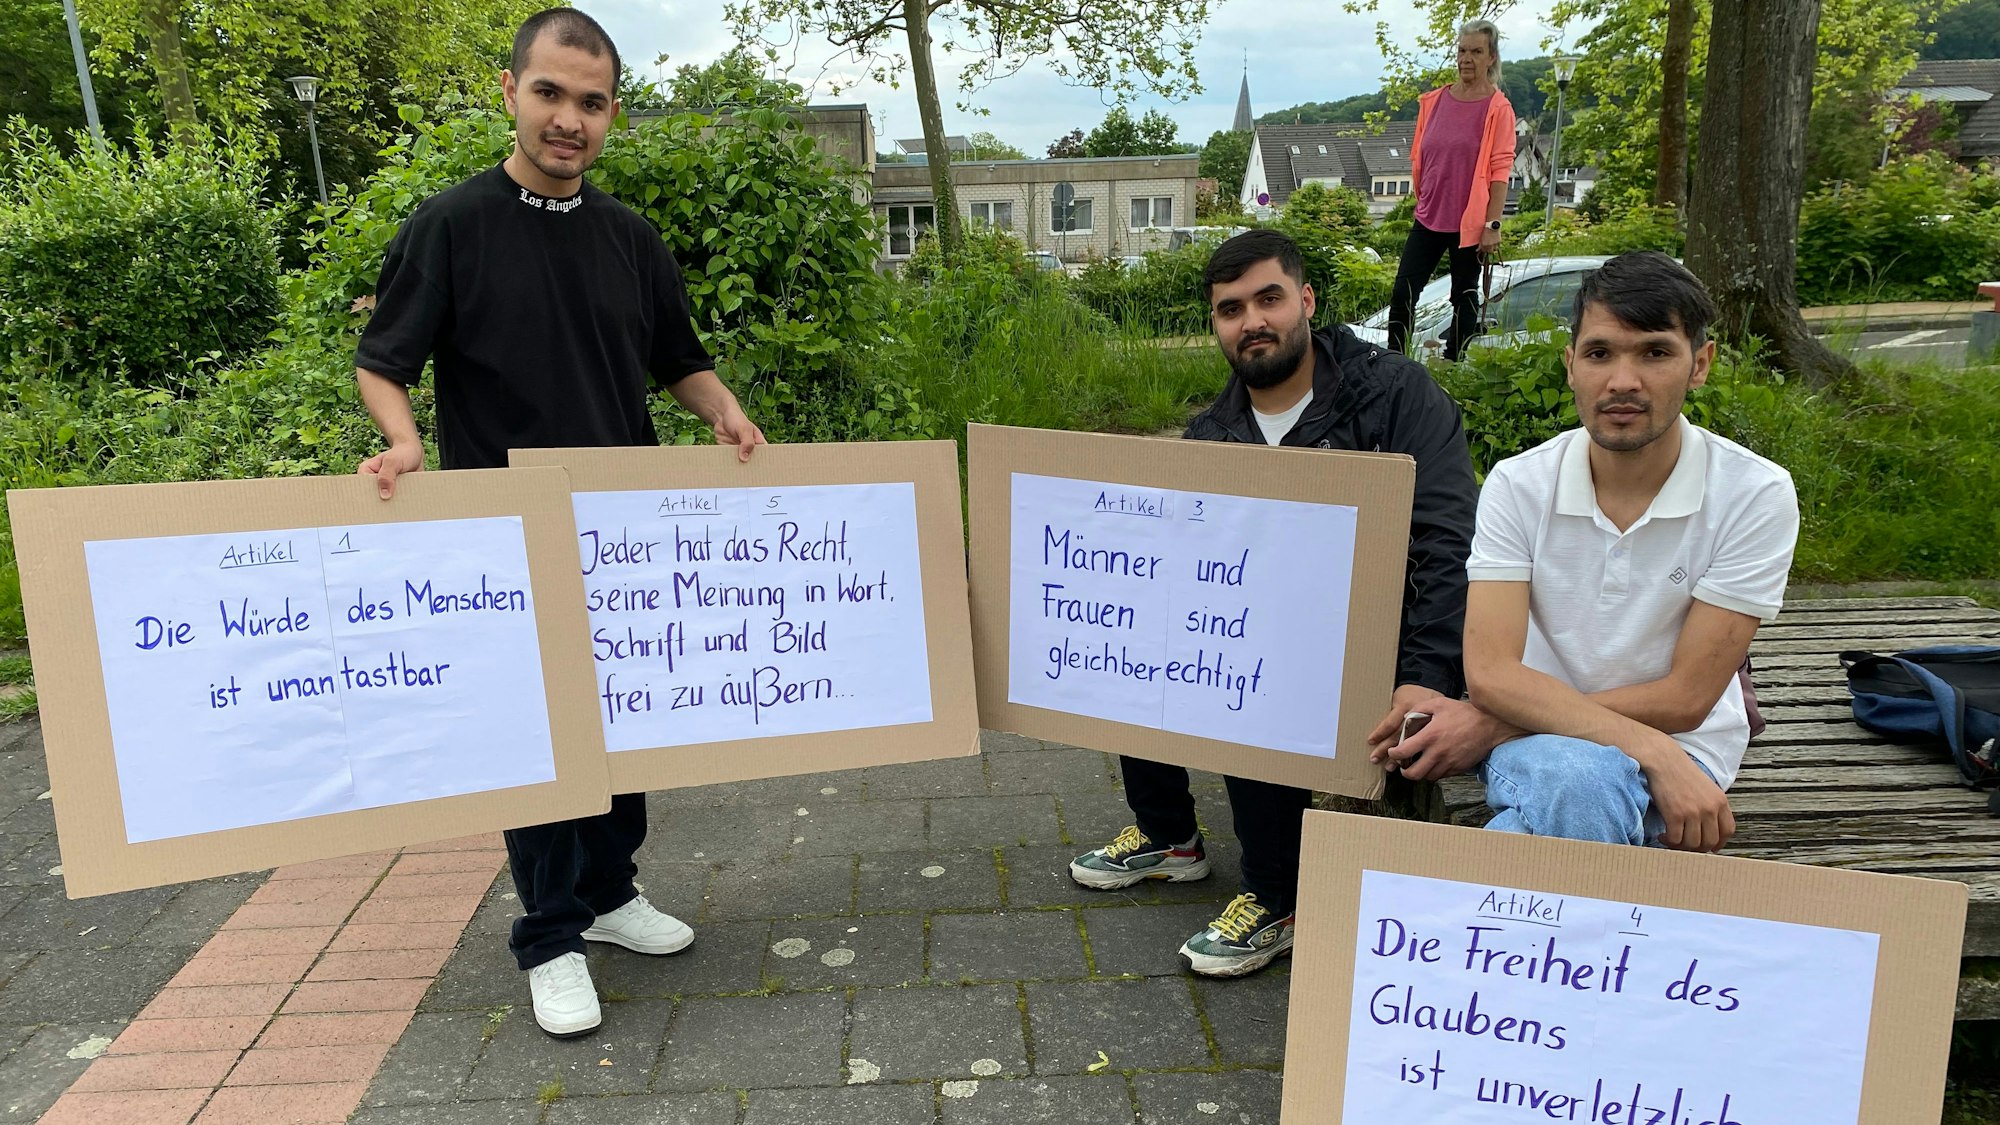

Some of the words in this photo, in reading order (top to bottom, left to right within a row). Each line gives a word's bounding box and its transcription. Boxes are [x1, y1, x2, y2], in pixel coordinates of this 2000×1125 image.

[519, 188, 543, 208] Los
[545, 194, 583, 213] Angeles
[657, 494, 720, 516] Artikel
[766, 495, 783, 510] 5
[1094, 490, 1164, 517] Artikel
[1192, 500, 1205, 518] 3
[220, 541, 298, 569] Artikel
[338, 532, 350, 552] 1
[579, 525, 661, 576] Jeder
[675, 523, 713, 564] hat
[723, 525, 769, 564] das
[778, 520, 853, 566] Recht,
[1044, 524, 1164, 580] Männer
[1197, 548, 1249, 587] und
[135, 615, 196, 651] Die
[219, 597, 311, 639] Würde
[346, 586, 394, 625] des
[404, 572, 526, 618] Menschen
[586, 583, 660, 613] seine
[673, 571, 786, 622] Meinung
[805, 579, 826, 604] in
[1042, 583, 1135, 631] Frauen
[1185, 606, 1249, 639] sind
[593, 620, 686, 674] Schrift
[704, 618, 749, 653] und
[768, 619, 828, 655] Bild
[209, 676, 242, 709] ist
[267, 651, 451, 703] unantastbar
[601, 672, 652, 725] frei
[670, 686, 704, 712] zu
[720, 665, 856, 726] äußern...
[1477, 890, 1565, 924] Artikel
[1629, 906, 1643, 926] 4
[1370, 917, 1442, 964] Die
[1465, 925, 1632, 994] Freiheit
[1664, 958, 1741, 1012] des
[1369, 983, 1567, 1050] Glaubens
[1400, 1049, 1446, 1091] ist
[1476, 1077, 1744, 1125] unverletzlh
